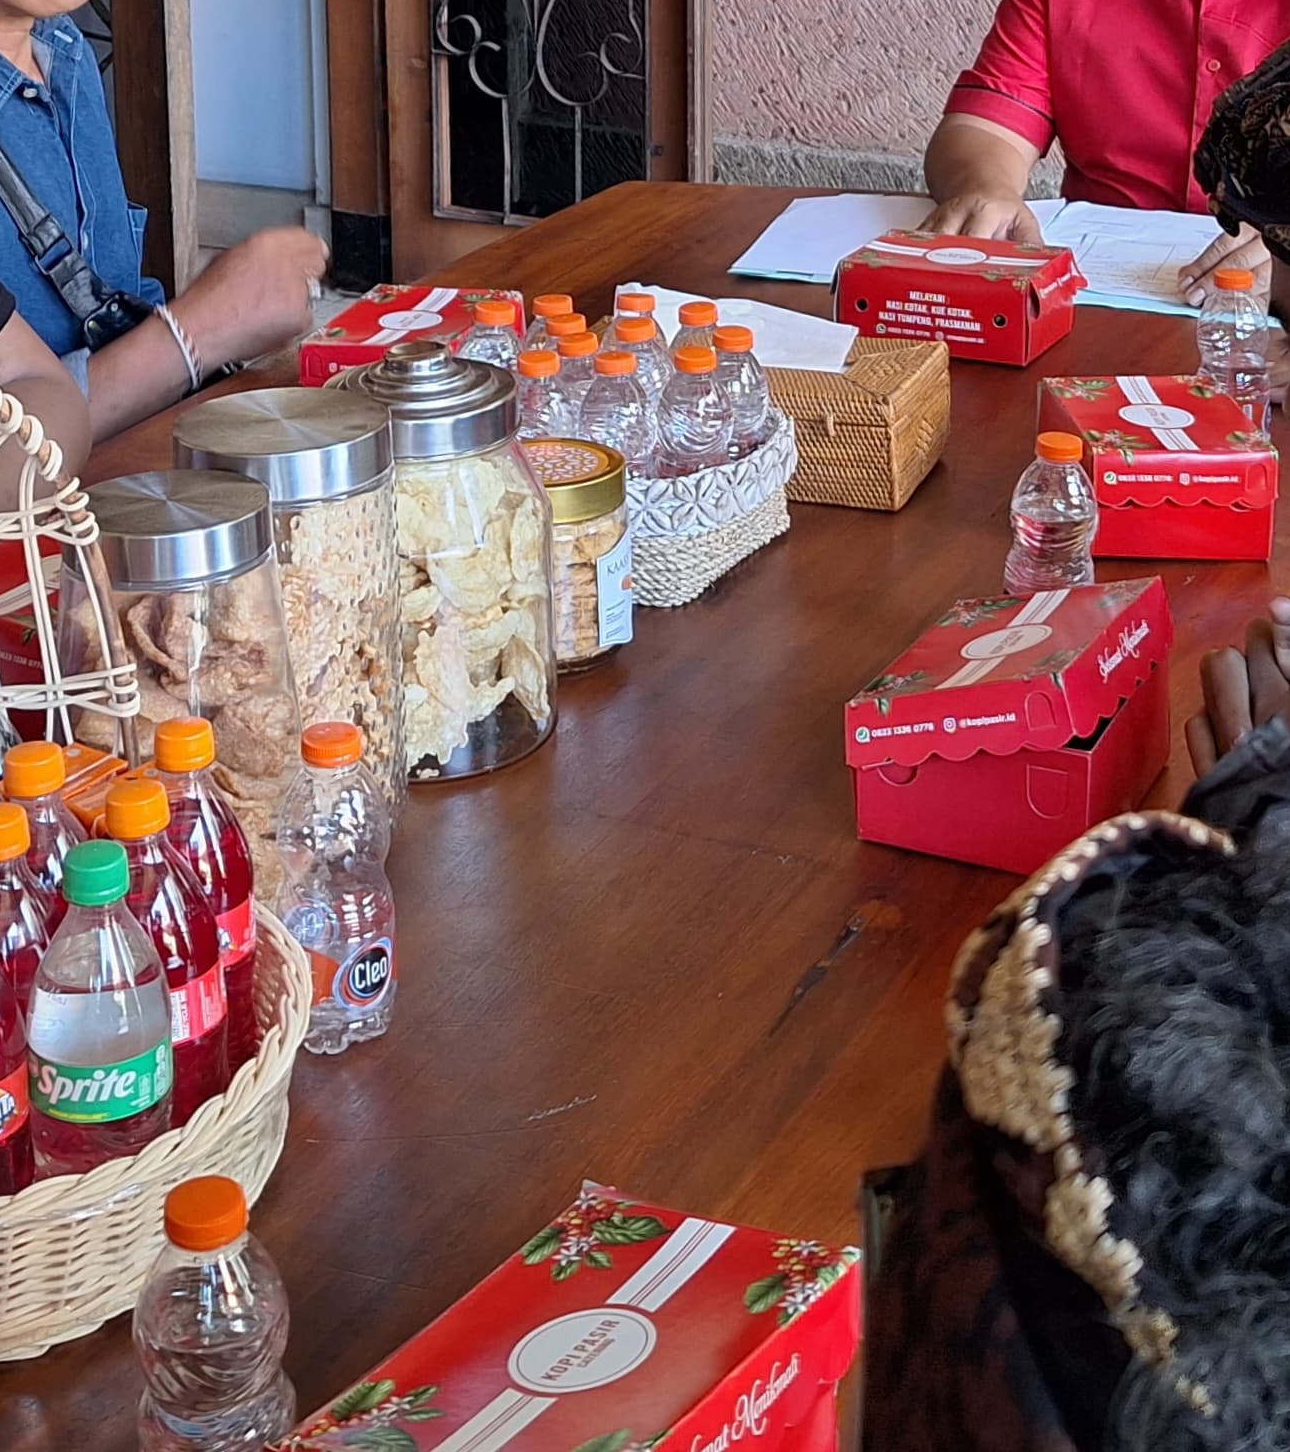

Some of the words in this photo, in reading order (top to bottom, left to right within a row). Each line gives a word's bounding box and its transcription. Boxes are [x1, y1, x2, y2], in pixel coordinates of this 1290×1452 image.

[355, 956, 387, 990] Cleo
[37, 1065, 136, 1104] Sprite
[541, 1354, 582, 1381] KOPI
[573, 1319, 621, 1353] PASIR
